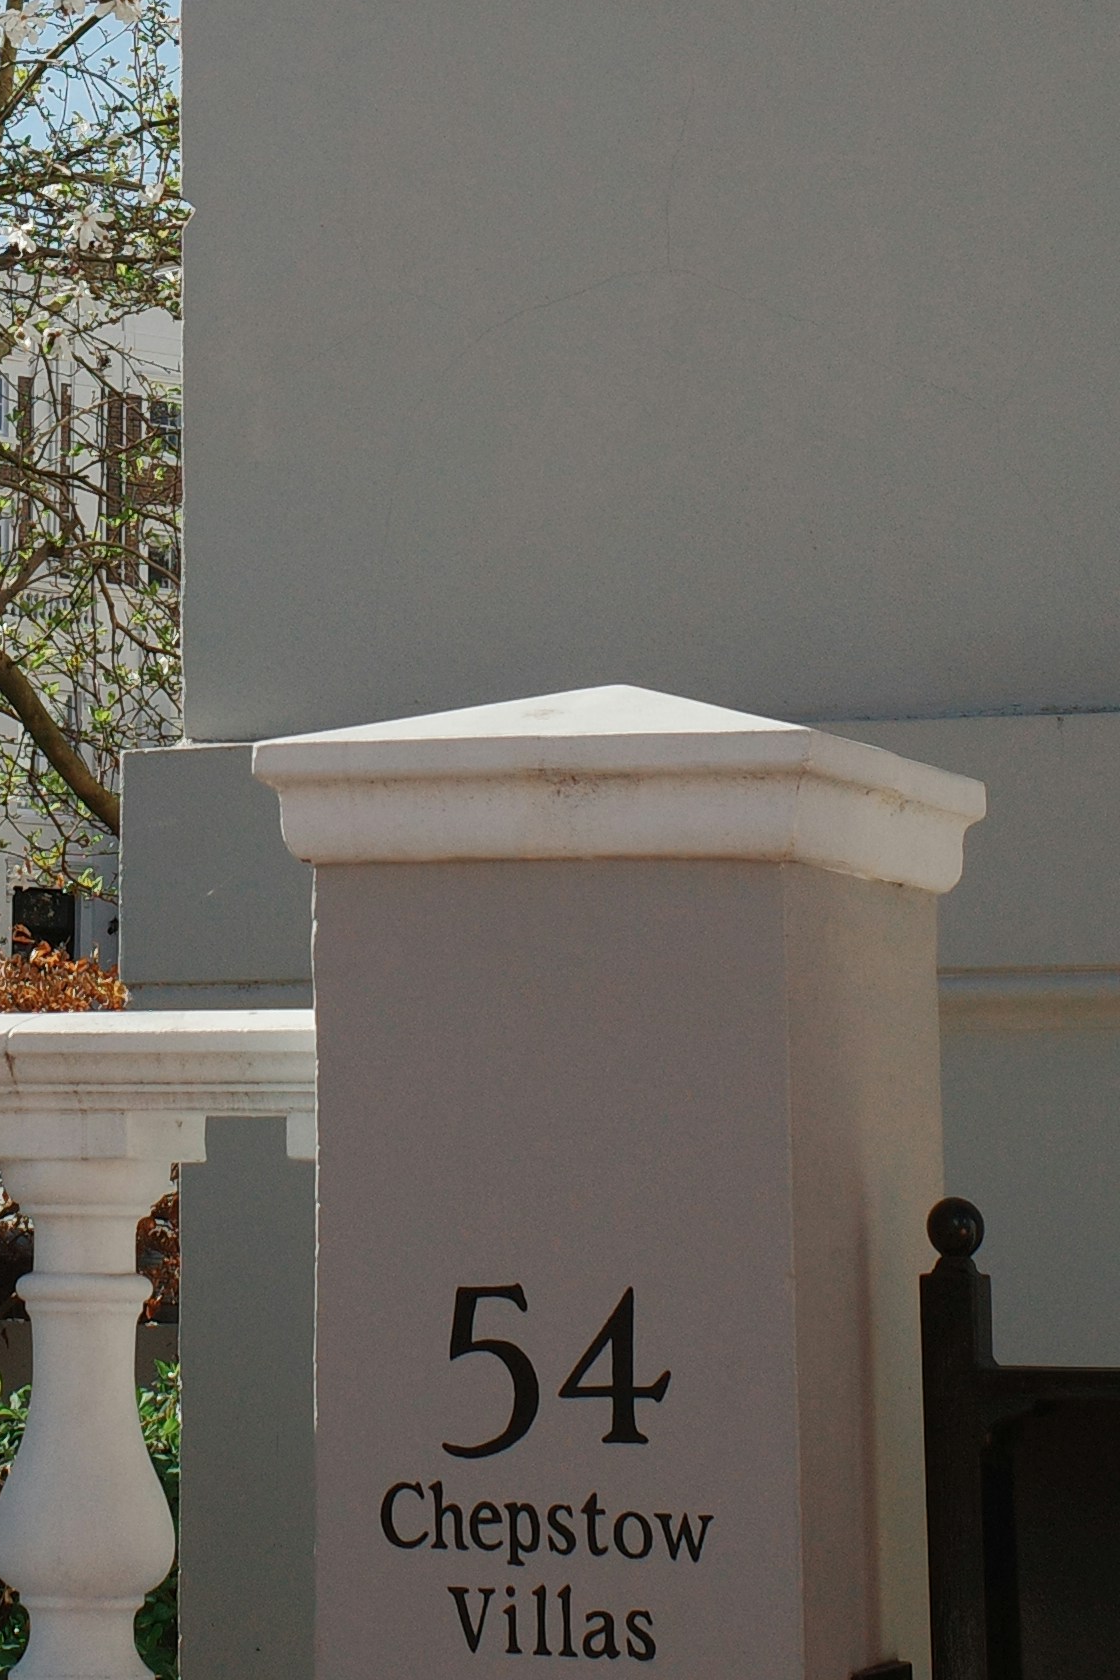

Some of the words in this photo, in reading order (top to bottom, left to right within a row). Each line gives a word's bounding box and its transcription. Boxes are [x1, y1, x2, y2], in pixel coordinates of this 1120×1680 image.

[441, 1282, 672, 1460] 54
[379, 1480, 715, 1568] Chepstow
[446, 1583, 657, 1663] Villas
